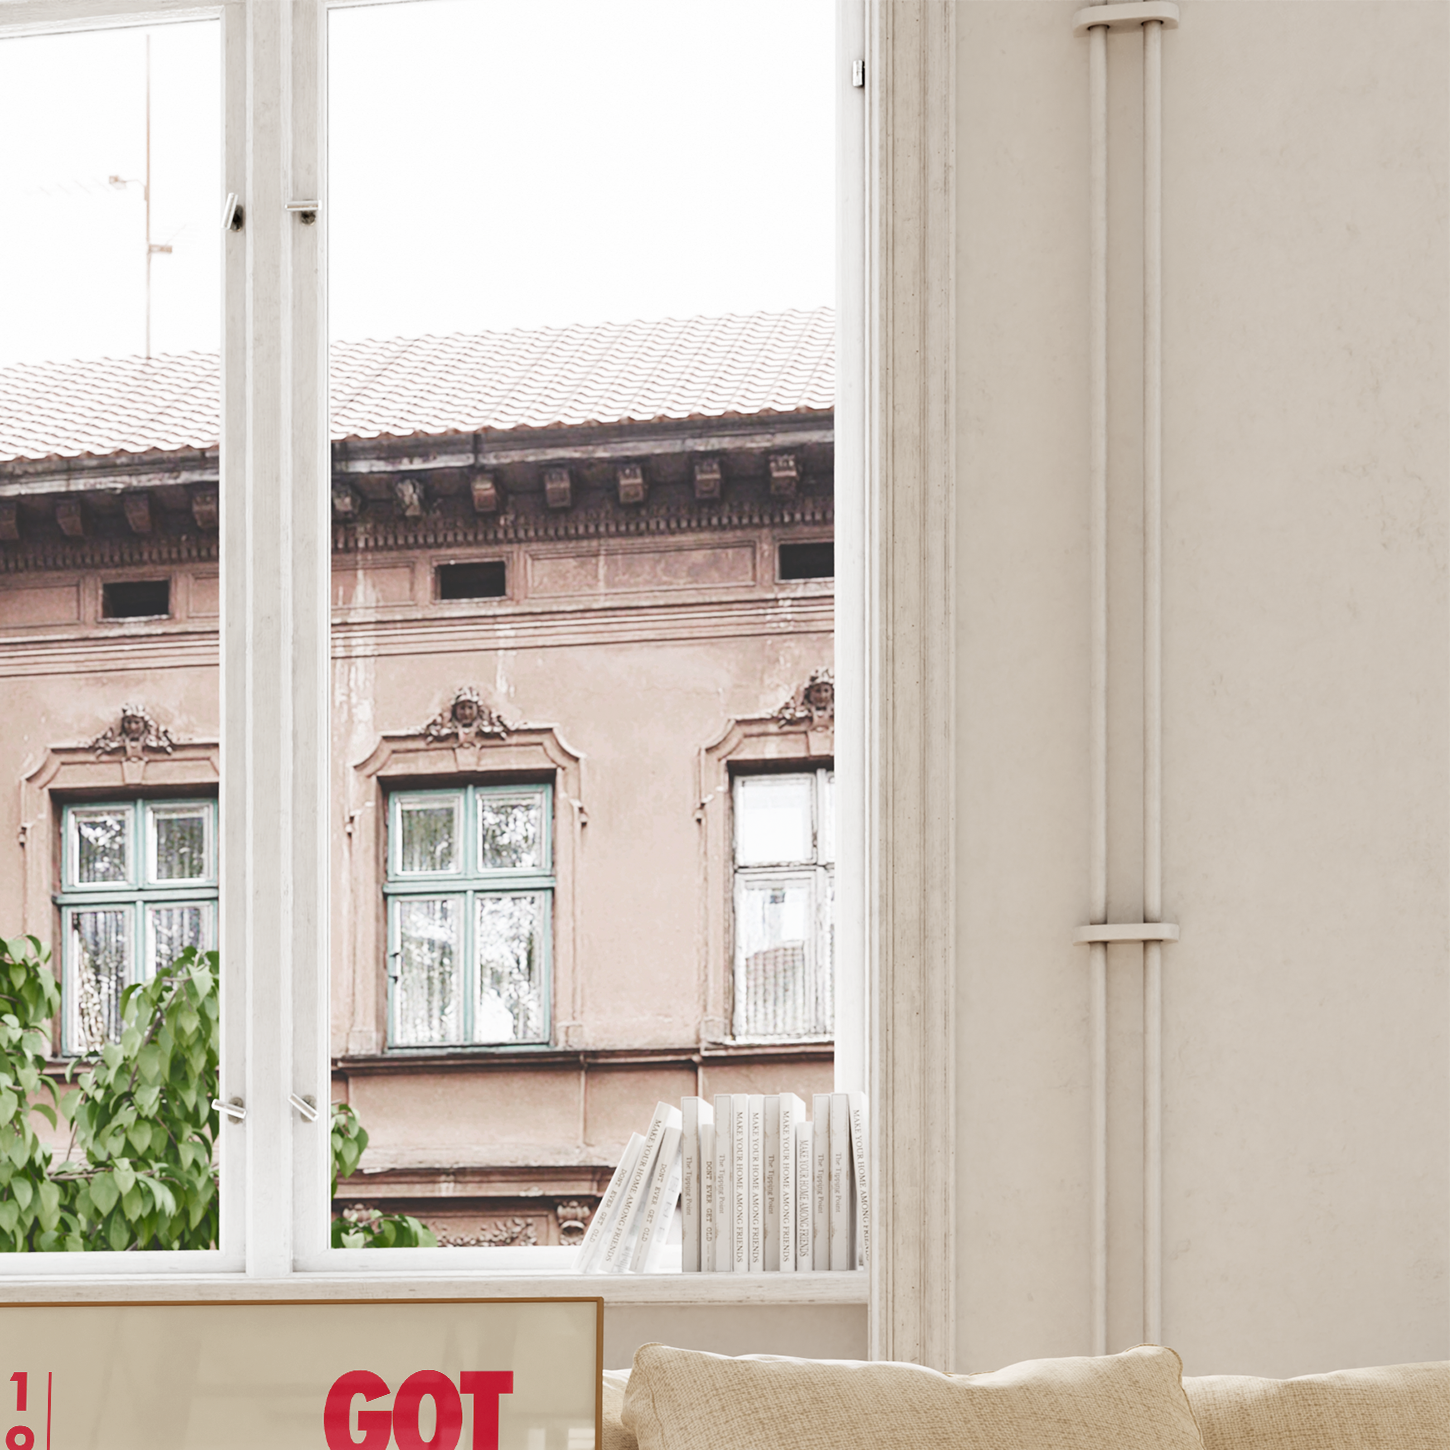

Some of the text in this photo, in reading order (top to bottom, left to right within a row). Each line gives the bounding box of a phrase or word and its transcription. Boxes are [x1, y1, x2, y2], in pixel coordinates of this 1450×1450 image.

[853, 1110, 861, 1135] MAKE
[855, 1135, 864, 1160] YOUR
[766, 1169, 775, 1196] Tipping
[857, 1161, 866, 1188] HOME
[605, 1120, 661, 1262] MAKE YOUR HOME AMONG FRIENDS
[799, 1140, 809, 1257] MAKE YOUR HOME AMONG FRIENDS
[859, 1190, 869, 1224] AMONG
